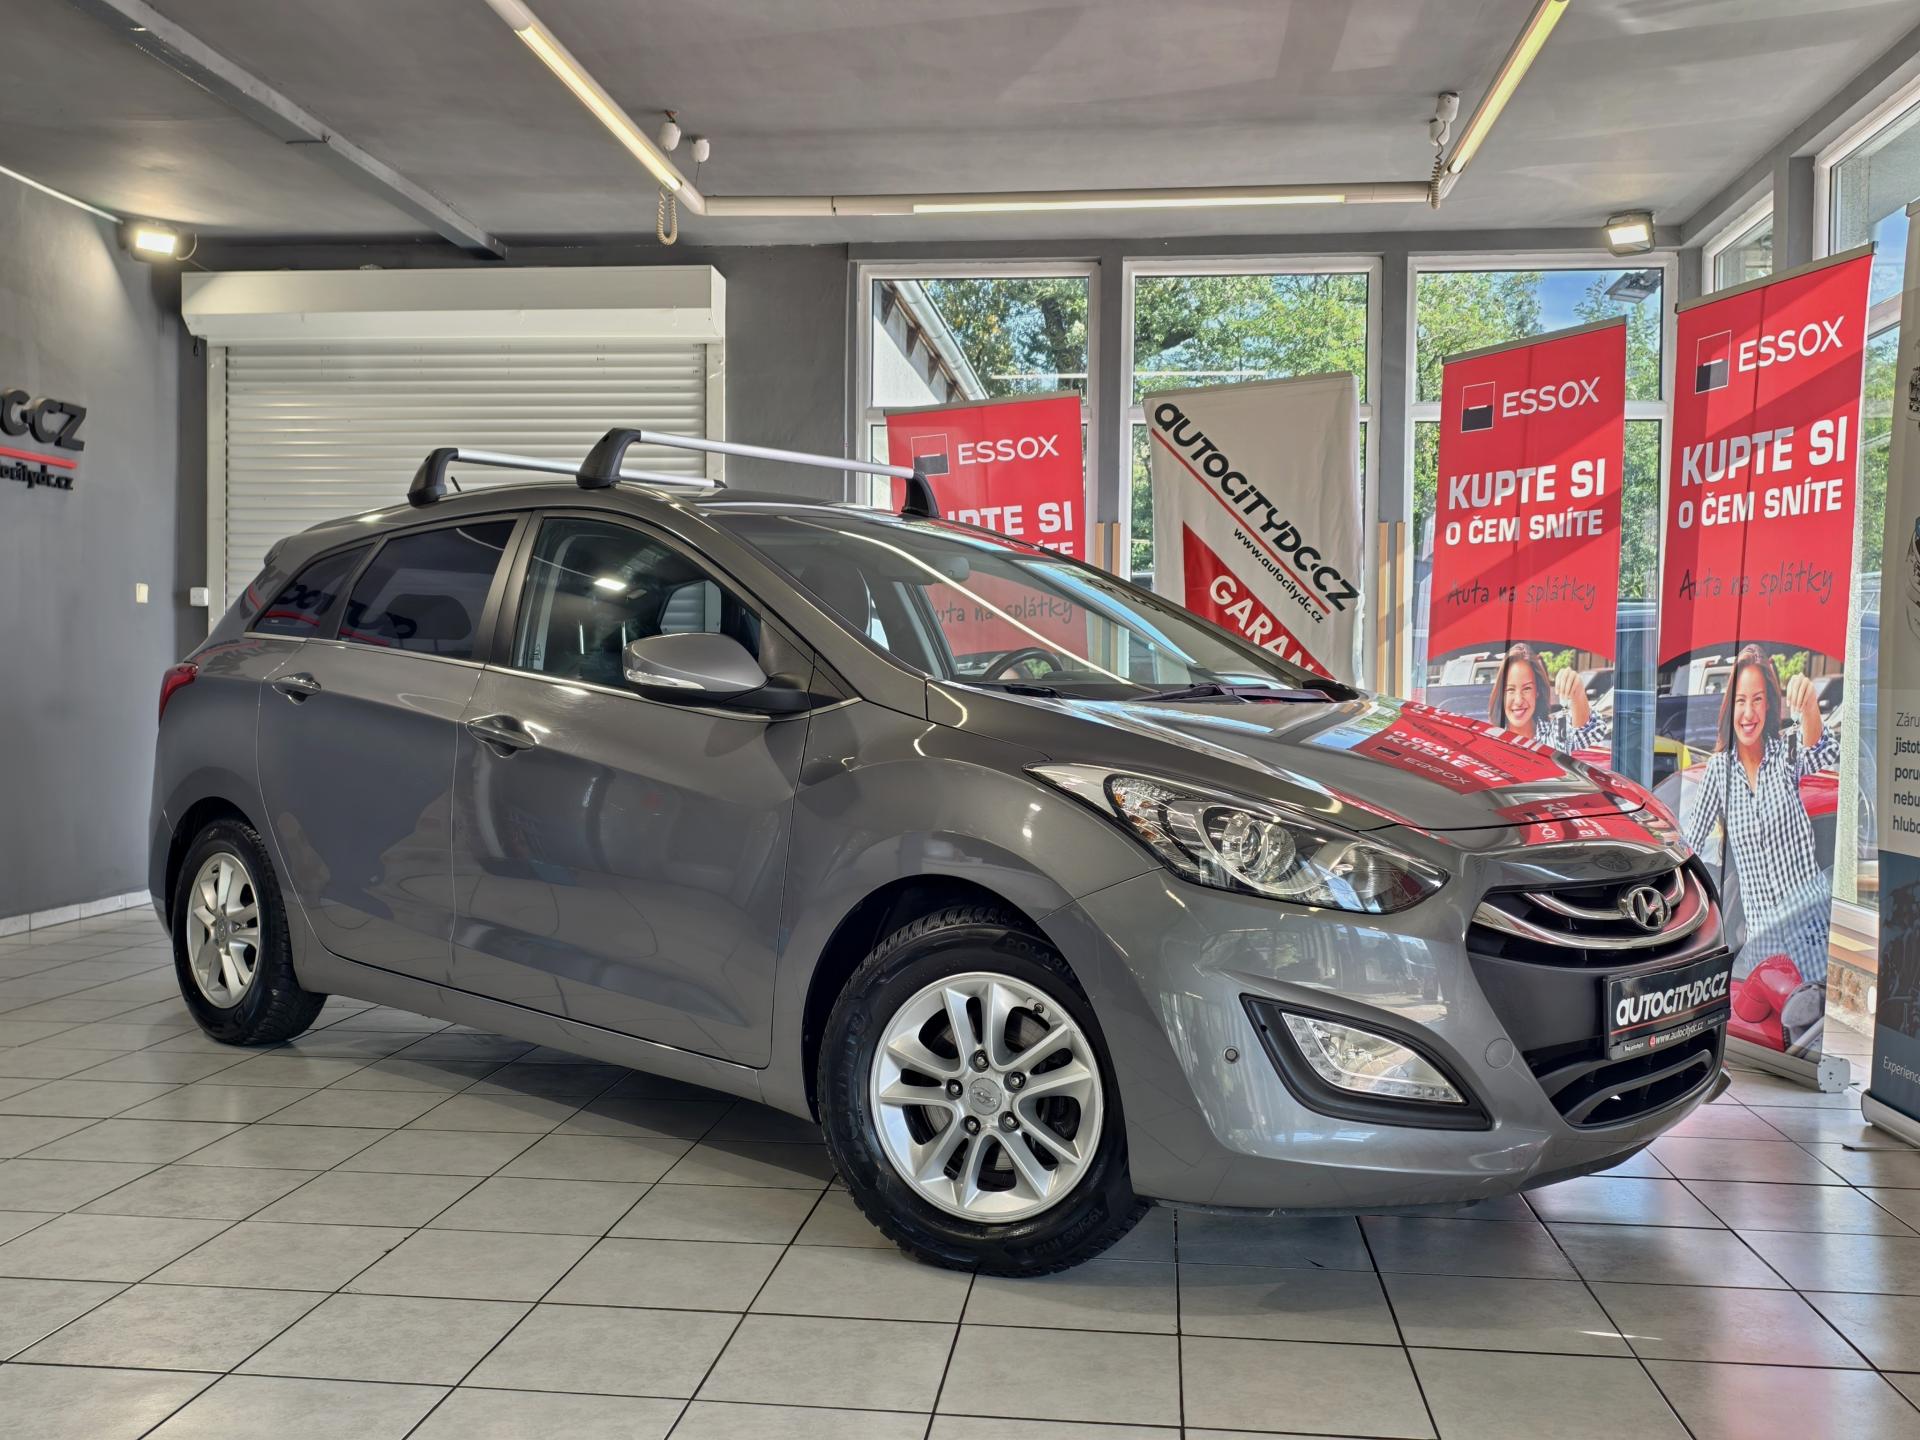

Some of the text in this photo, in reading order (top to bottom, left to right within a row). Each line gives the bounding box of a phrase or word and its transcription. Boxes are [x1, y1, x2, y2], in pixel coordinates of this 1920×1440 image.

[1738, 315, 1845, 373] ESSOX
[1502, 377, 1600, 418] ESSOX
[957, 434, 1059, 466] ESSOX
[1681, 415, 1848, 487] KUPTE SI
[1448, 458, 1606, 510] KUPTE SI
[1678, 476, 1843, 529] O ČEM SNÍTE
[1037, 501, 1073, 533] SI
[1445, 506, 1603, 546] O ČEM SNÍTE
[1233, 528, 1324, 624] www.autocitydc.cz
[1498, 583, 1516, 604] na
[1525, 576, 1597, 611] splátky
[1679, 560, 1833, 606] Auta na splátky
[1005, 594, 1073, 624] splátky
